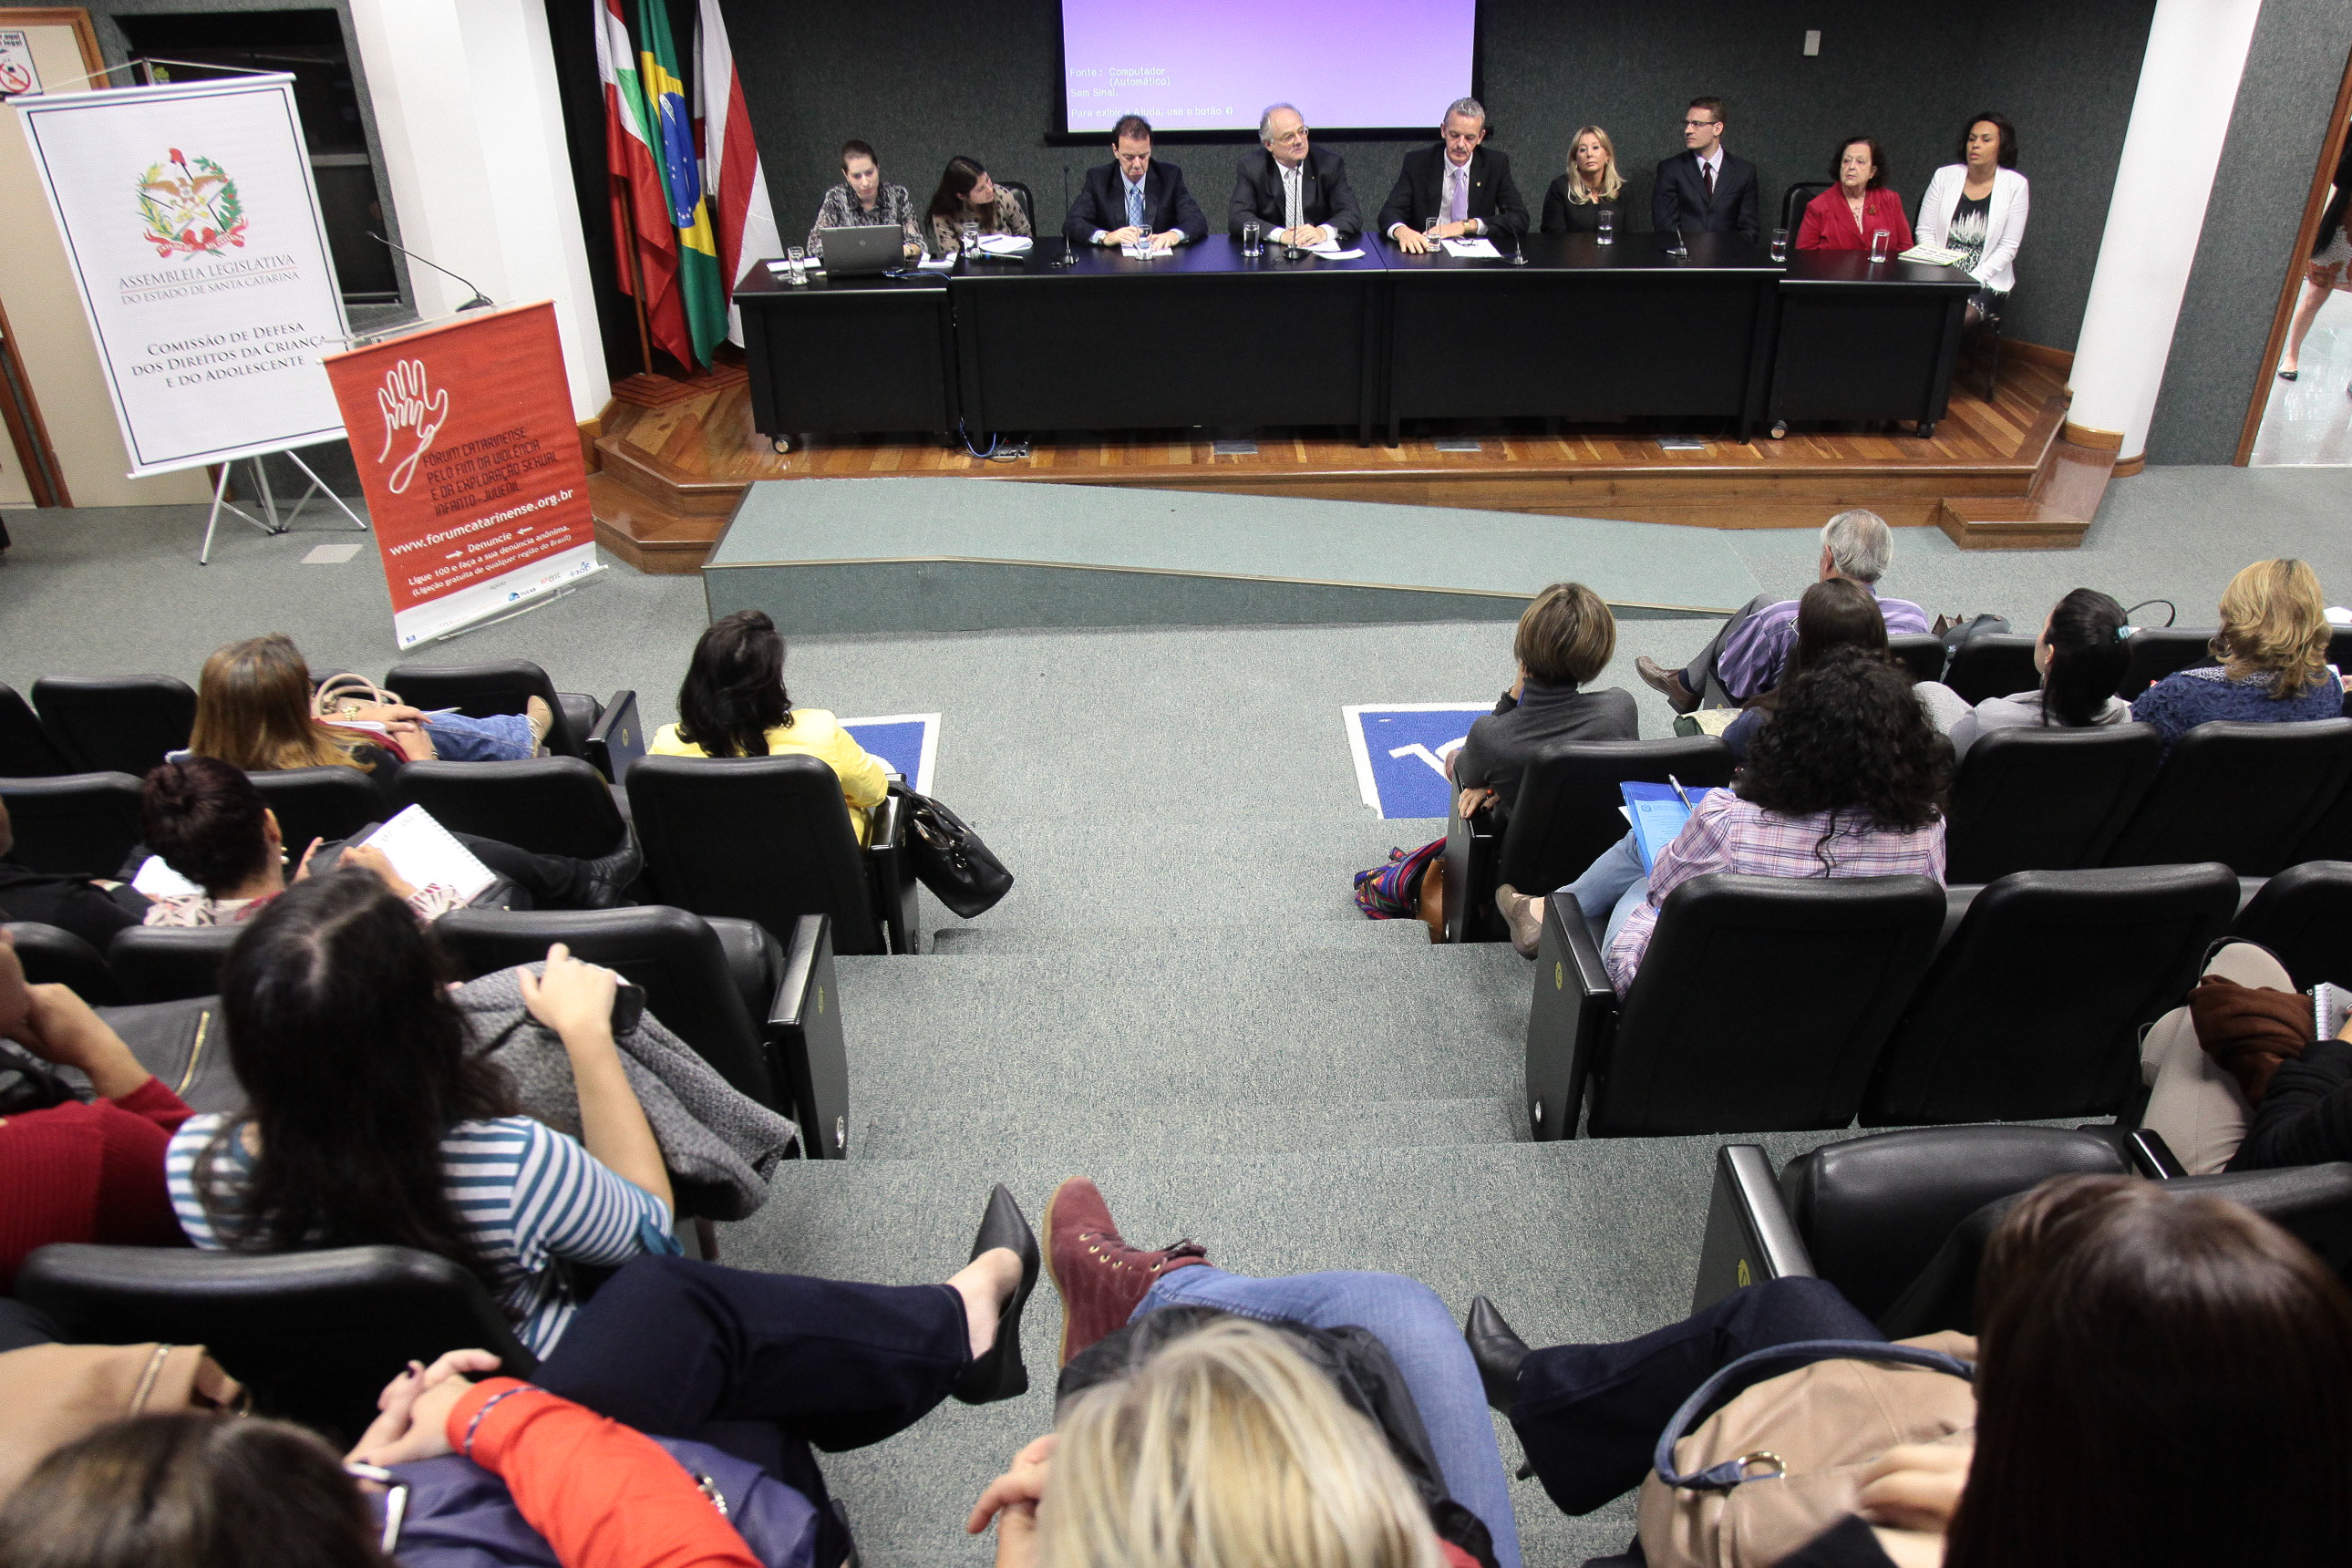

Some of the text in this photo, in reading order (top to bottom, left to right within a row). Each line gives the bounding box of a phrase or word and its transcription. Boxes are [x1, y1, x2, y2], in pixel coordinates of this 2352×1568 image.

[1109, 67, 1165, 77] Computador
[1070, 88, 1119, 97] Sem Sinal.
[1071, 108, 1093, 118] Para
[1096, 108, 1121, 117] exibir
[1195, 107, 1222, 116] botão
[119, 253, 296, 290] ASSEMBLEIA LEGISLATIVA
[121, 271, 300, 304] DO ESTADO DE SANTA CATARINA
[131, 335, 326, 376] DOS DIREITOS DA CRIANÇA
[147, 323, 305, 356] COMISSÃO DE DEFESA
[166, 355, 305, 387] E DO ADOLESCENTE
[462, 427, 527, 456] CATARINENSE
[427, 466, 453, 484] PELO
[456, 459, 476, 476] FIM
[478, 456, 491, 469] DA
[430, 451, 559, 500] E DA EXPLORAÇÃO SEXUAL
[389, 489, 573, 557] www.forumcatarinense.org.br
[468, 531, 512, 553] Denuncie
[407, 573, 433, 586] Ligue
[434, 566, 450, 577] 100
[451, 563, 458, 572] e
[459, 558, 476, 571] faça
[484, 551, 498, 562] sua
[500, 538, 534, 556] denúncia
[445, 573, 473, 588] gratuita
[475, 566, 484, 575] de
[485, 557, 517, 573] qualquer
[517, 549, 538, 562] região
